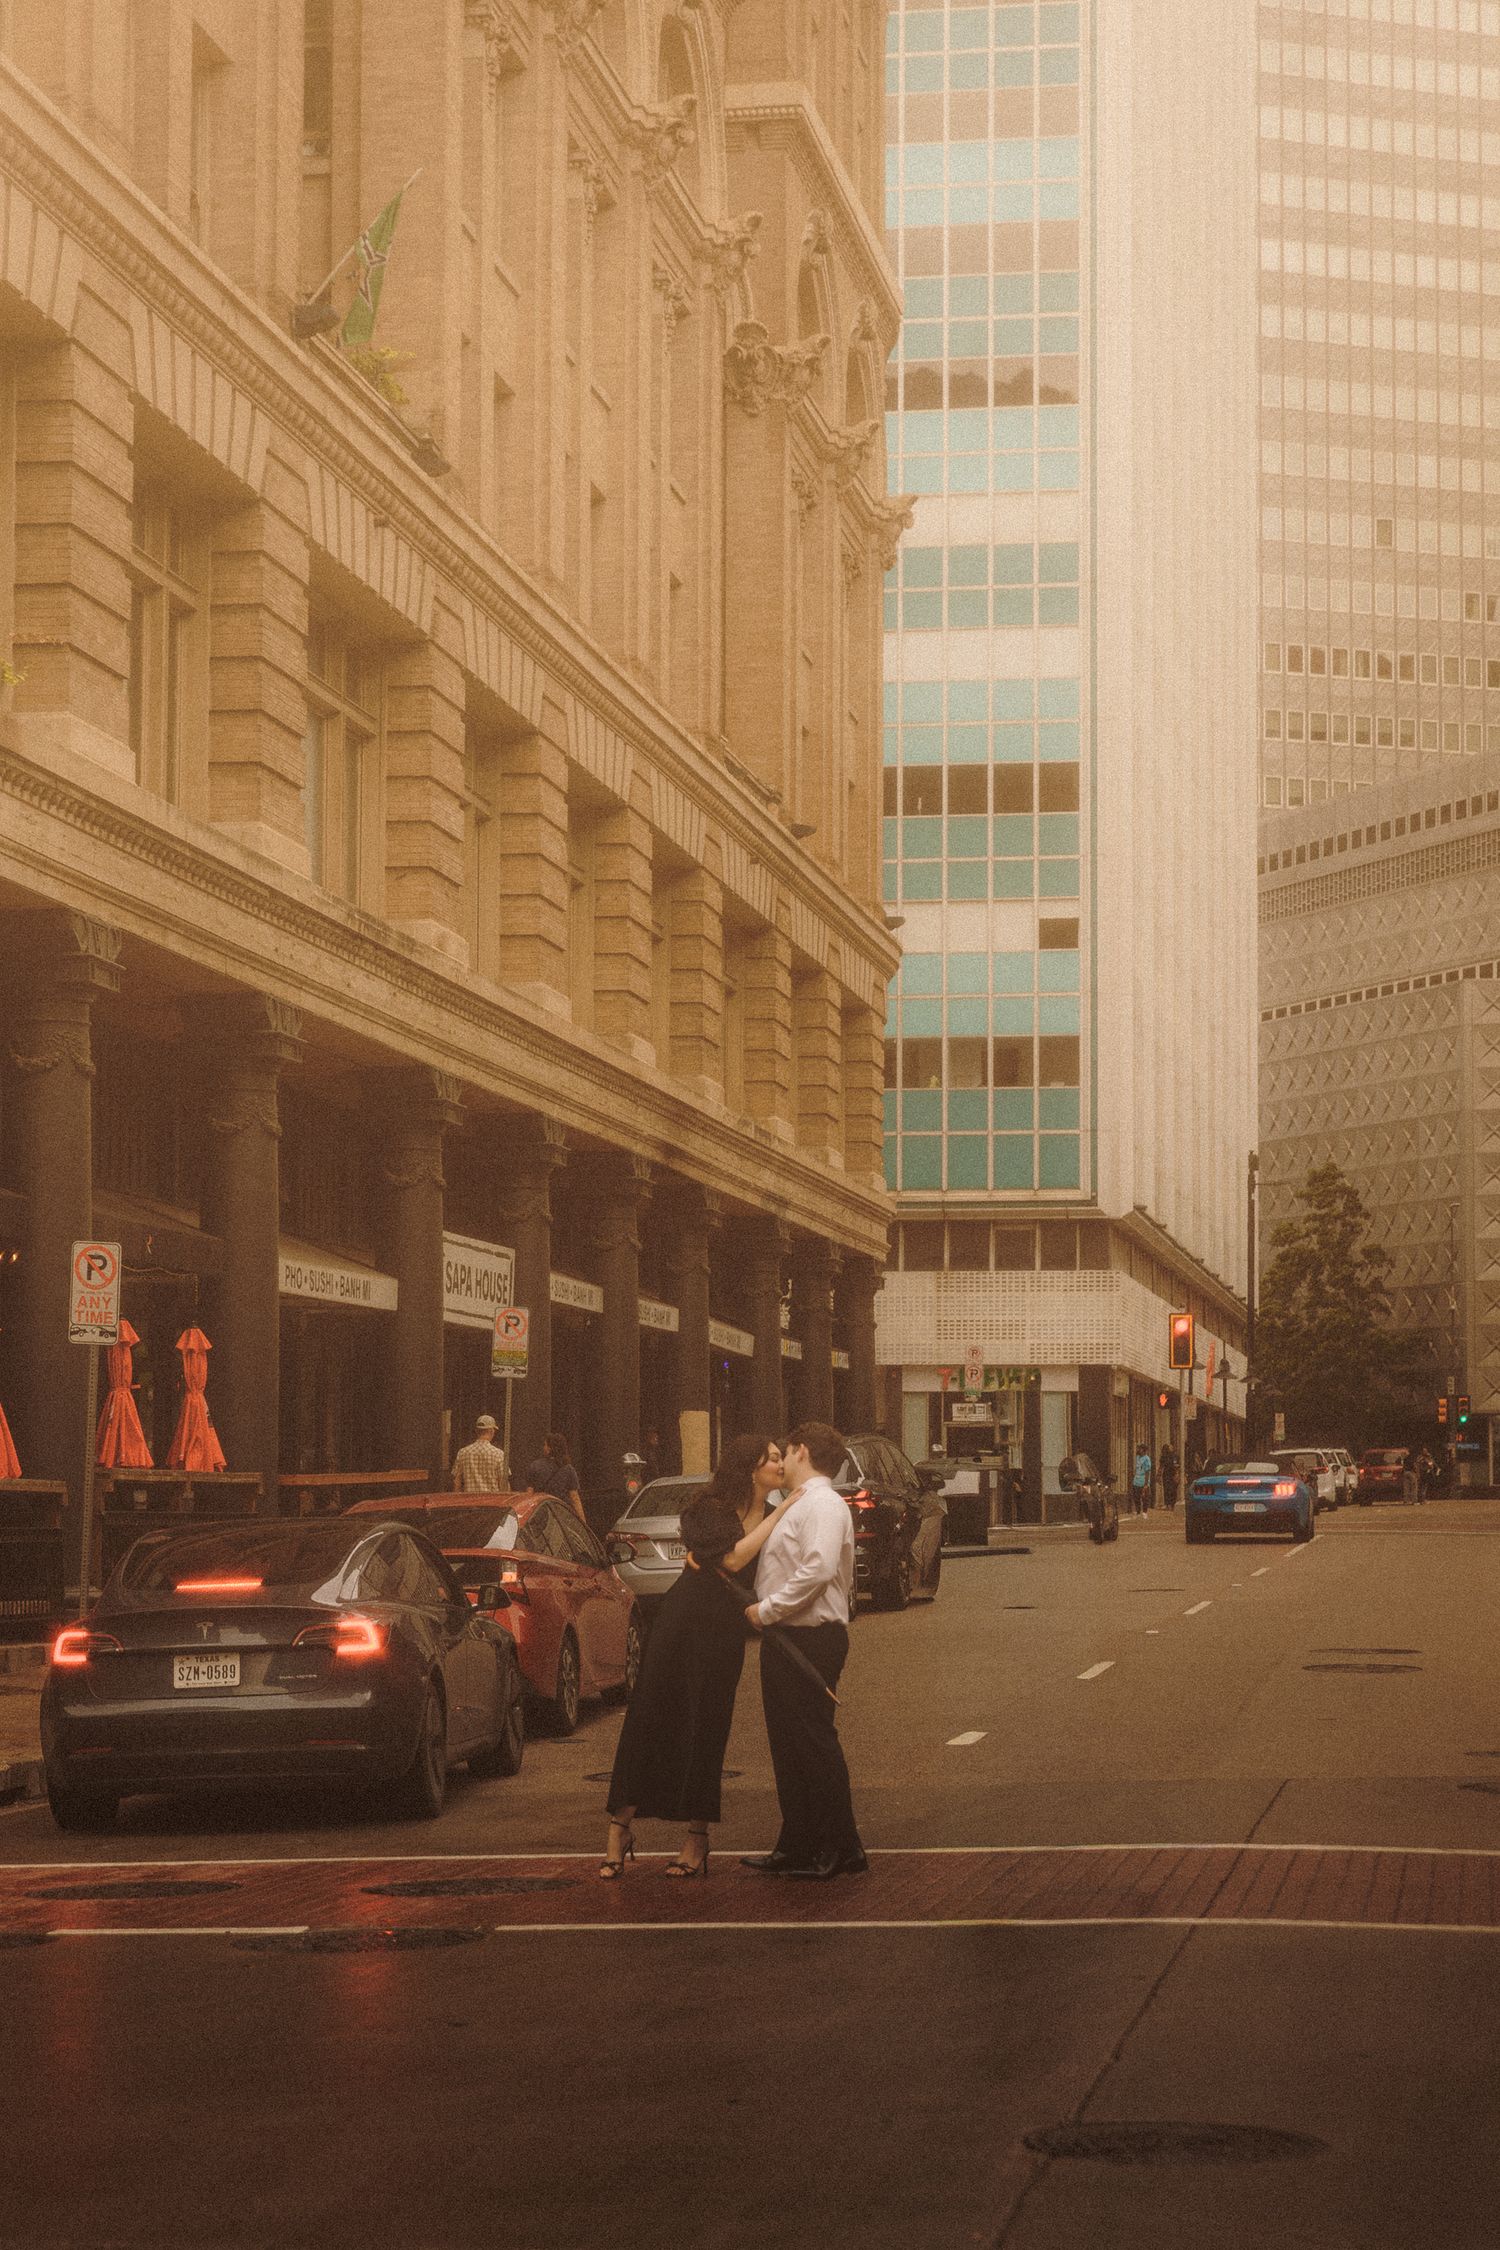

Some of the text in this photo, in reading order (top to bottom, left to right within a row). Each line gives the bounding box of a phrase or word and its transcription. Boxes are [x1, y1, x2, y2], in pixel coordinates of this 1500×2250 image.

[285, 1264, 303, 1289] PHO
[308, 1269, 334, 1294] SUSHI
[339, 1275, 361, 1299] BANH
[445, 1260, 509, 1305] SAPA HOUSE
[78, 1295, 112, 1310] ANY
[75, 1310, 113, 1325] TIME
[194, 1655, 220, 1663] TEXAS
